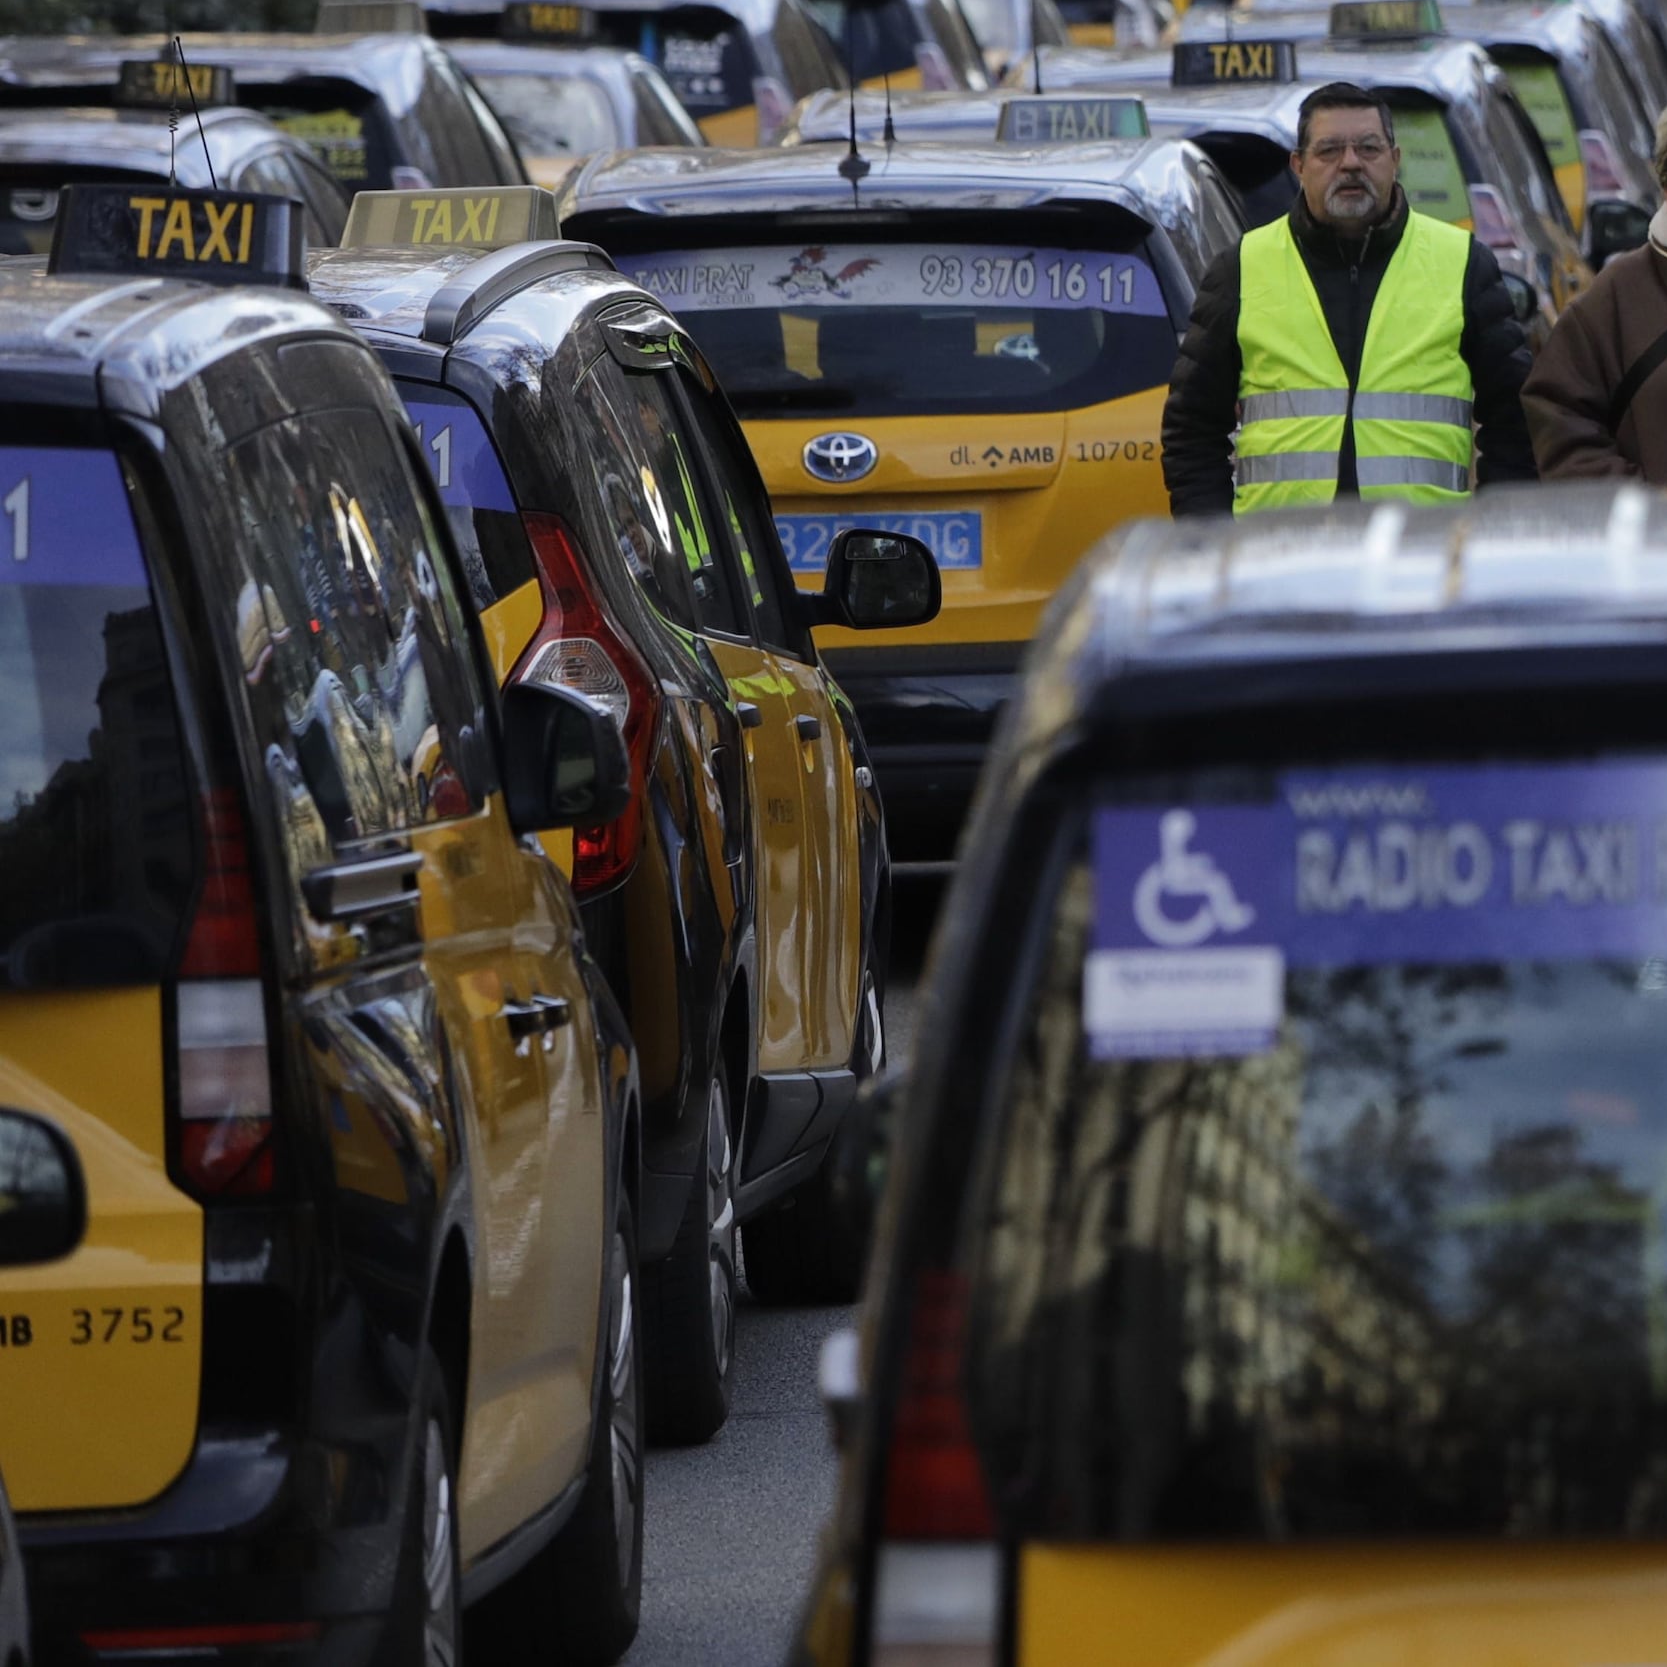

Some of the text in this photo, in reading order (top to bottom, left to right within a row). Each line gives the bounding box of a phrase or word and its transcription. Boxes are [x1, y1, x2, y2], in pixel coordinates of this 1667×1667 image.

[1209, 44, 1273, 78] TAXI
[1046, 102, 1110, 139] TAXI
[129, 197, 254, 263] TAXI
[411, 197, 500, 243] TAXI
[634, 263, 754, 297] TAXI PRAT
[920, 254, 1135, 304] 93 370 16 11
[950, 441, 1155, 466] dl. AMB 10702
[3, 474, 32, 561] 1
[1297, 820, 1493, 916] RADIO
[1506, 820, 1638, 910] TAXI
[70, 1306, 185, 1346] 3752
